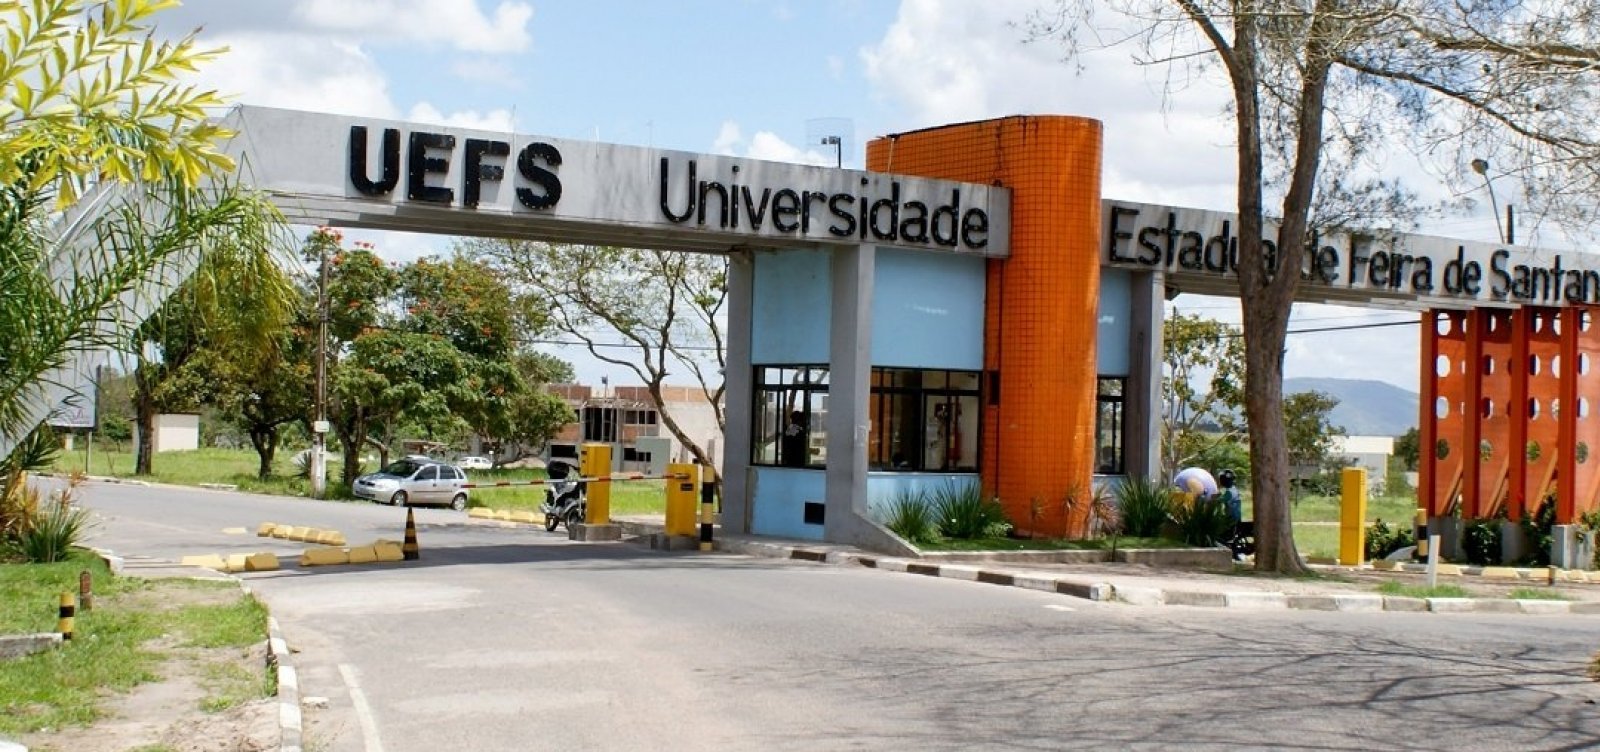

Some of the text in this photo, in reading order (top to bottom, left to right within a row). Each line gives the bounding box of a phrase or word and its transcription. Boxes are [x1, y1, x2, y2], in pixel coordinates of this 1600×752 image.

[350, 126, 988, 249] UEFS Universidade
[1109, 206, 1600, 302] Estada de Feira de Santan
